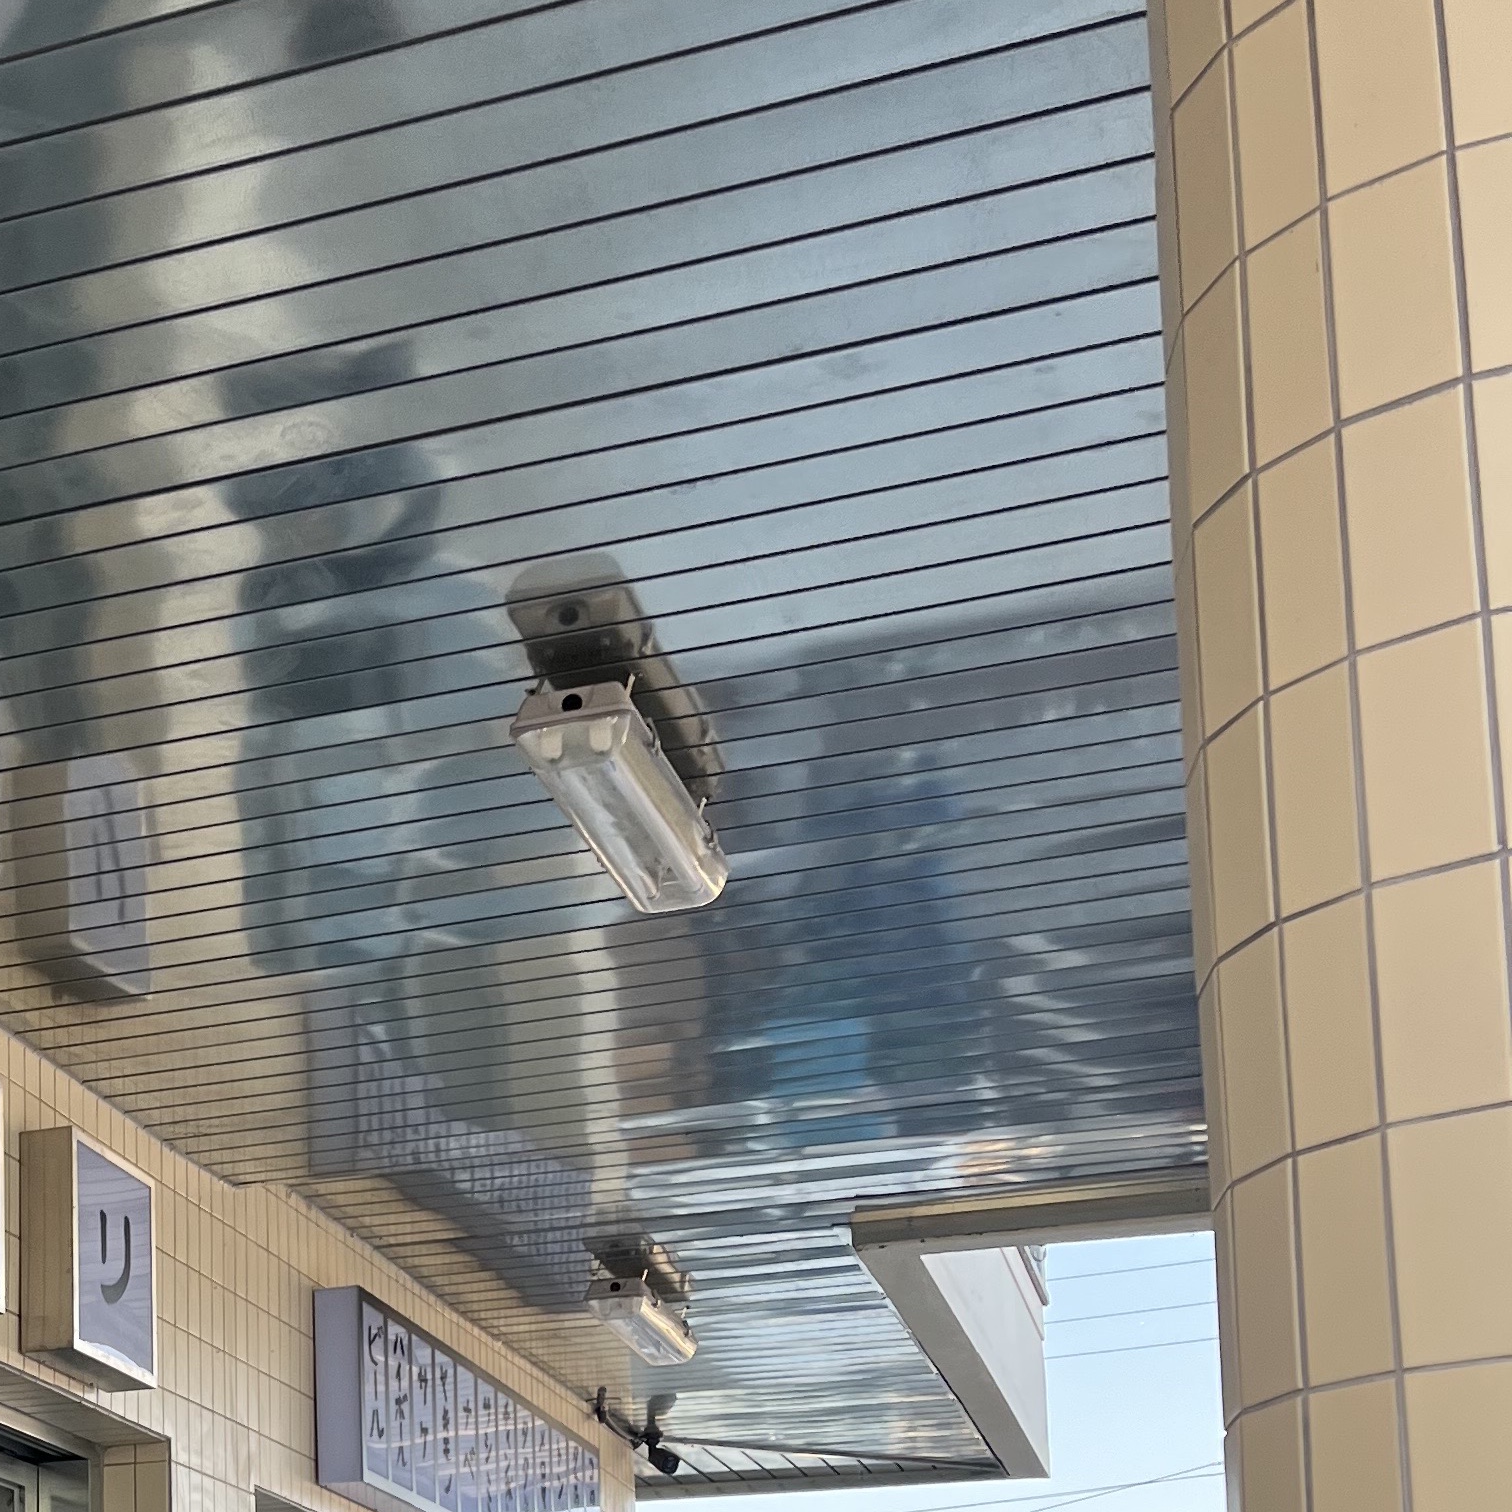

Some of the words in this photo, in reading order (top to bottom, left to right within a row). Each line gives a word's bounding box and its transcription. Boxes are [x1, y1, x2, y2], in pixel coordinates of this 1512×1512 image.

[100, 1208, 131, 1305] リ
[368, 1325, 384, 1440] ビール
[393, 1333, 408, 1468] ハイボール
